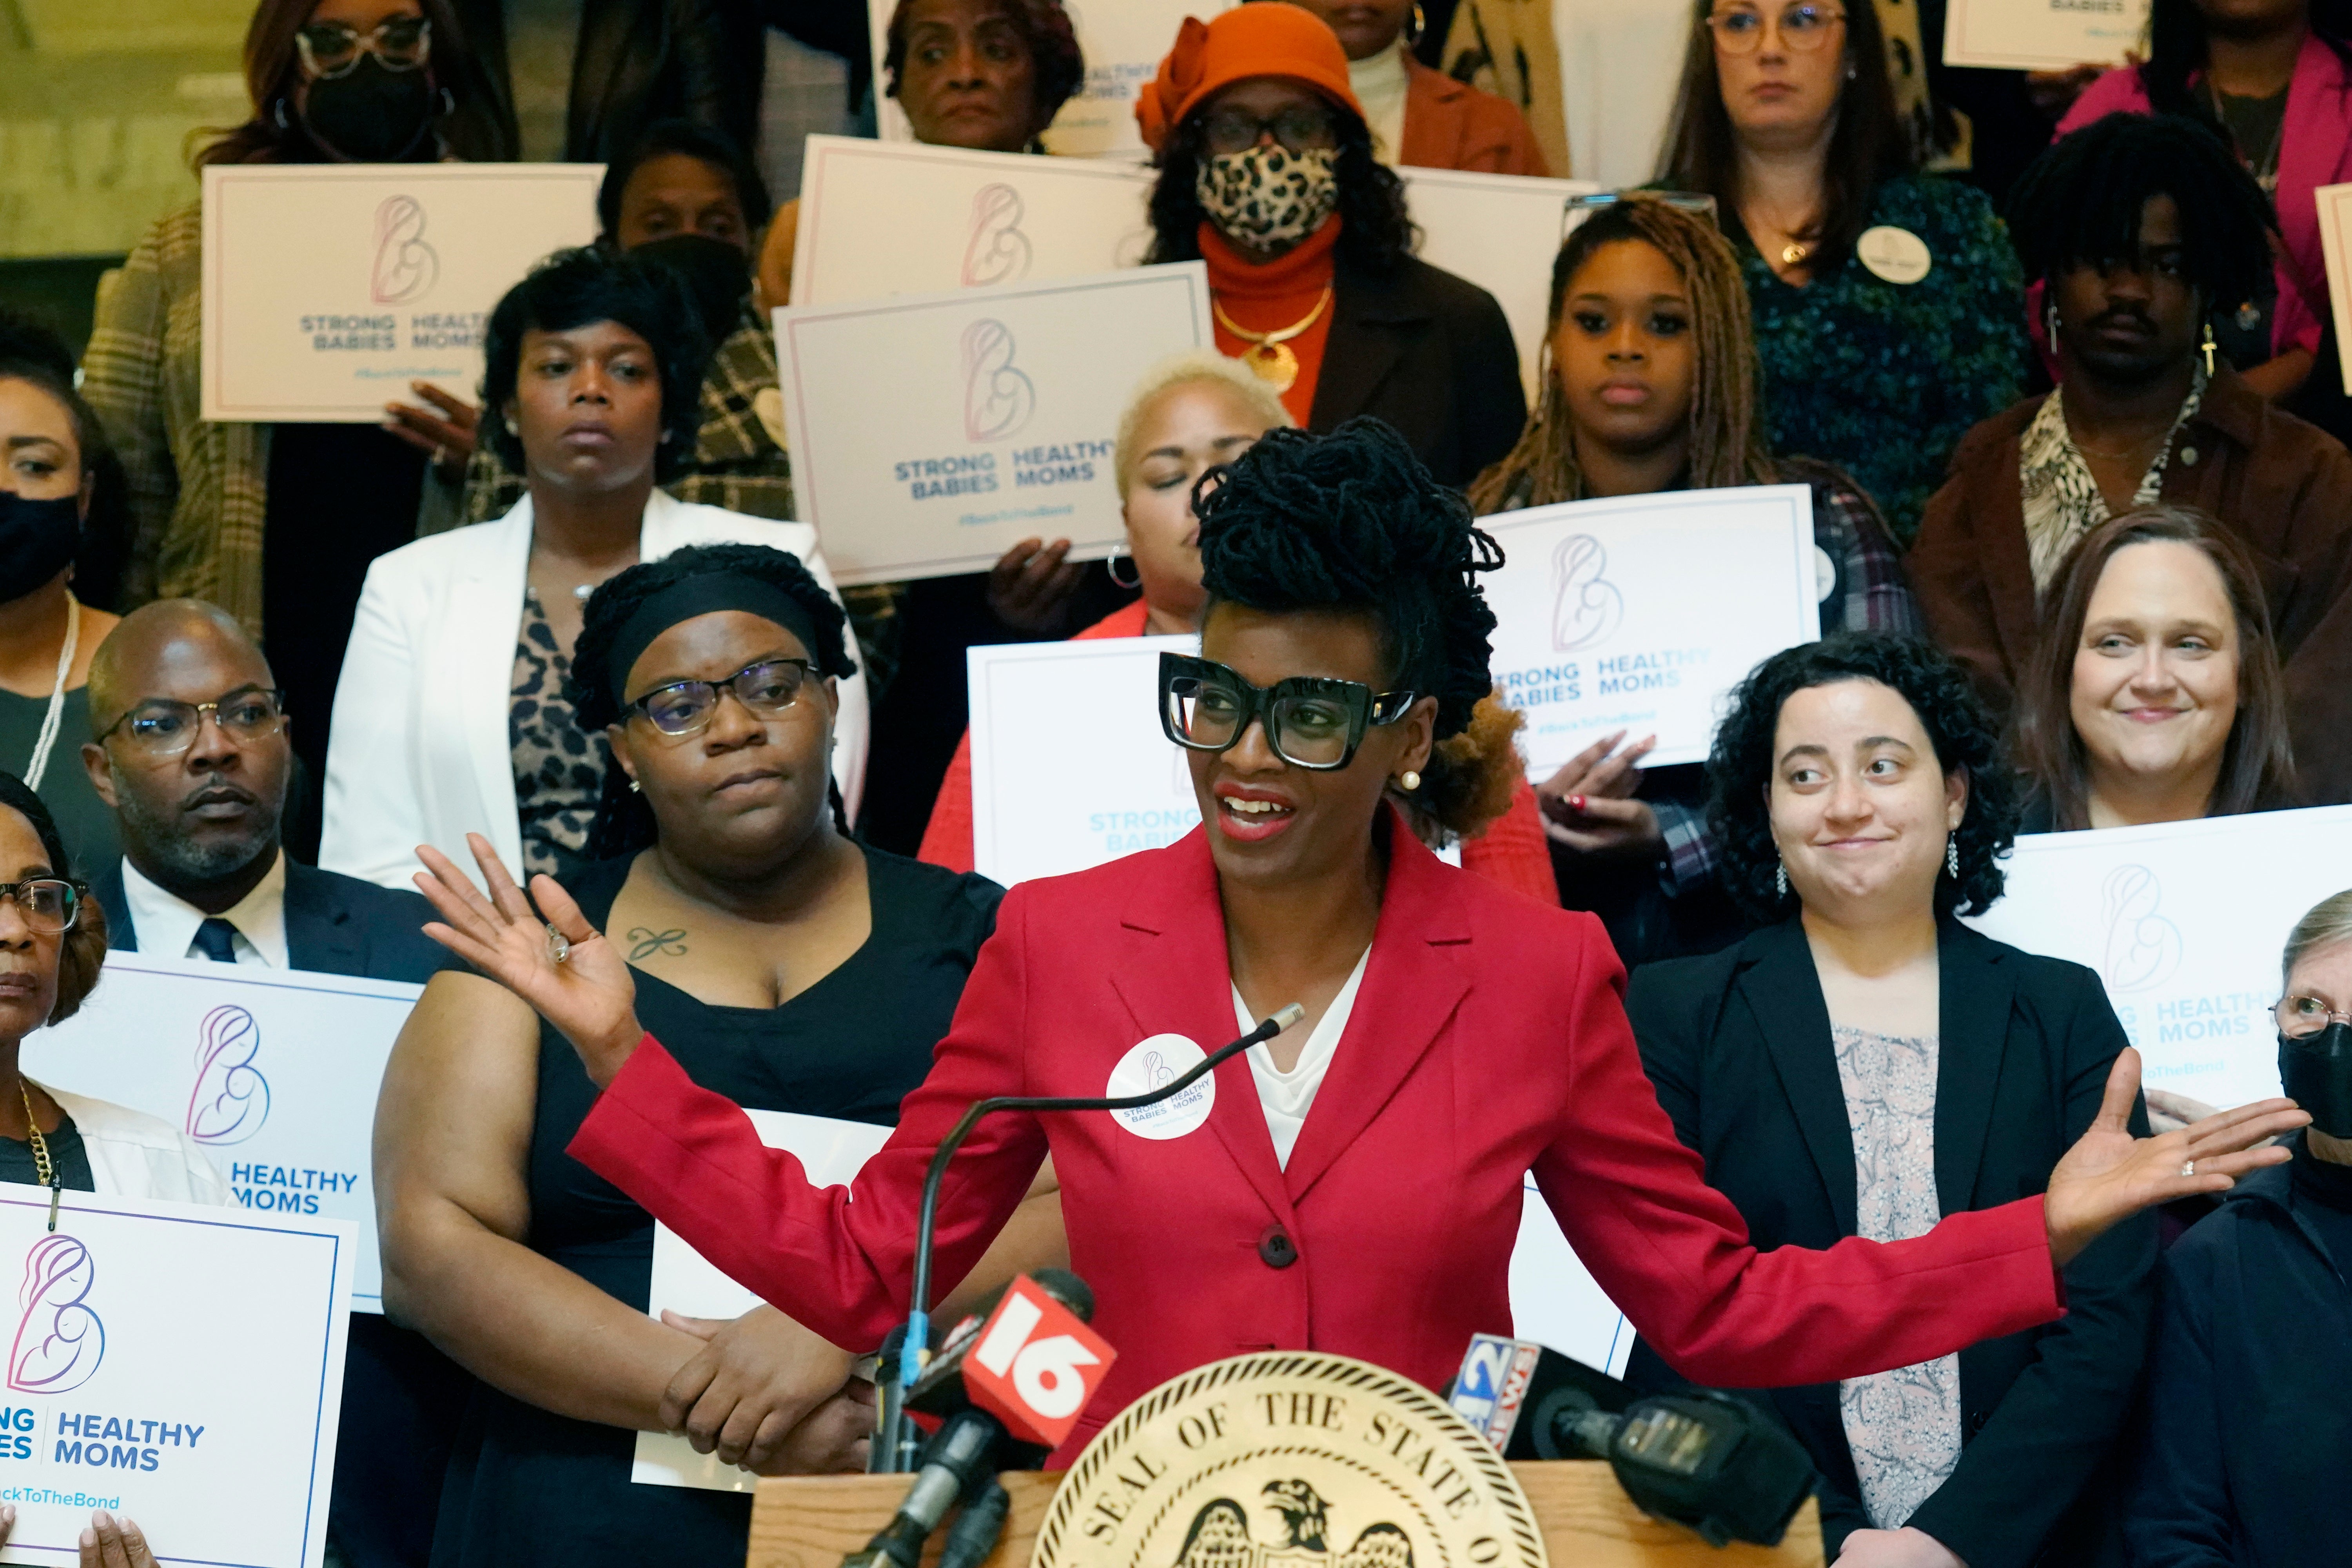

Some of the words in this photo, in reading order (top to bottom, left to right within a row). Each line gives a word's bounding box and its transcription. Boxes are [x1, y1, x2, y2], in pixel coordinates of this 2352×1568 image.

[300, 315, 394, 332] STRONG
[411, 312, 485, 328] HEALT
[313, 334, 394, 350] BABIES
[895, 453, 996, 481] STRONG
[911, 472, 999, 500] BABIES
[1015, 462, 1095, 486] MOMS
[1494, 663, 1580, 687] TRONG
[1598, 648, 1711, 674] HEALTHY
[1501, 684, 1581, 707] ABIES
[1600, 670, 1680, 695] MOMS
[1090, 809, 1200, 831] STRONG
[1106, 830, 1185, 851] BABIE
[2159, 1015, 2250, 1044] MOMS
[1171, 1078, 1210, 1103] HEALTHY
[1132, 1108, 1167, 1123] BABIES
[1173, 1093, 1203, 1110] MOMS
[231, 1162, 358, 1193] HEALTHY
[975, 1291, 1102, 1419] 16
[58, 1412, 205, 1448] HEALTHY
[55, 1439, 159, 1472] MOMS
[1083, 1454, 1167, 1546] SEAL
[1178, 1402, 1228, 1450] OF
[1256, 1391, 1347, 1432] THE
[1363, 1411, 1480, 1520] STATE
[1468, 1535, 1510, 1568] O
[0, 1486, 120, 1510] ckToTheBond
